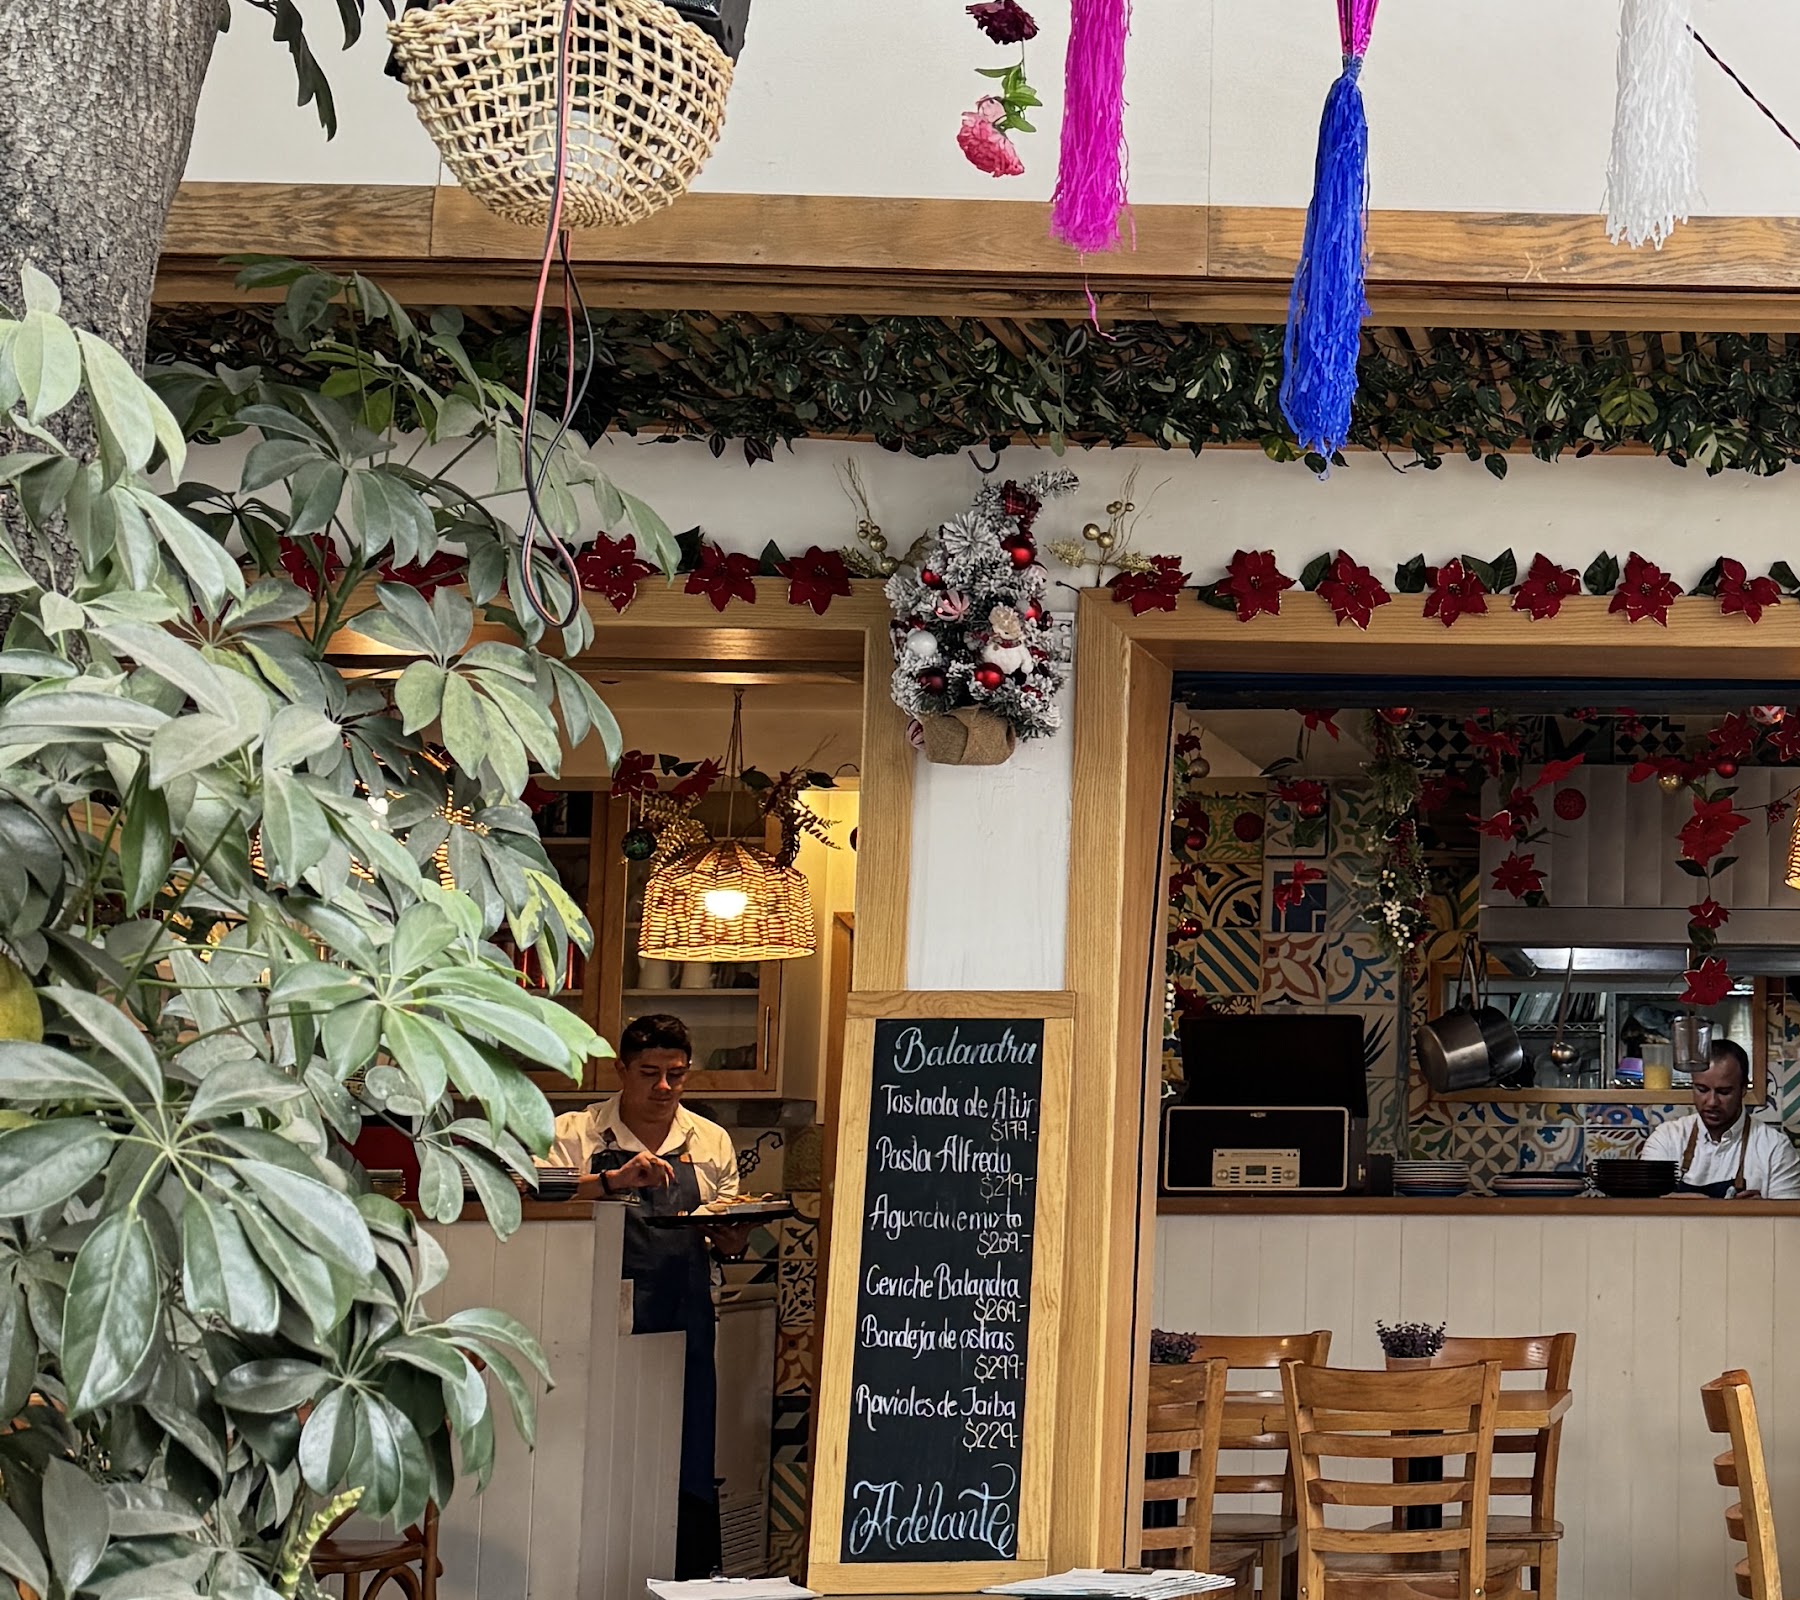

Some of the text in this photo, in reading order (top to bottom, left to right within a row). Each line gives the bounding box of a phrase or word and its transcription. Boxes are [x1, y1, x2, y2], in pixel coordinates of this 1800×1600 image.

[893, 1025, 1038, 1074] Balandra
[963, 1085, 989, 1118] de
[875, 1134, 1011, 1174] Pasta Alfredo
[865, 1260, 1021, 1300] Ceviche Balandra
[861, 1313, 1015, 1360] Bandeja de ostras
[855, 1383, 1016, 1432] Ravioles de Jaiba
[849, 1462, 1016, 1558] Adelante
